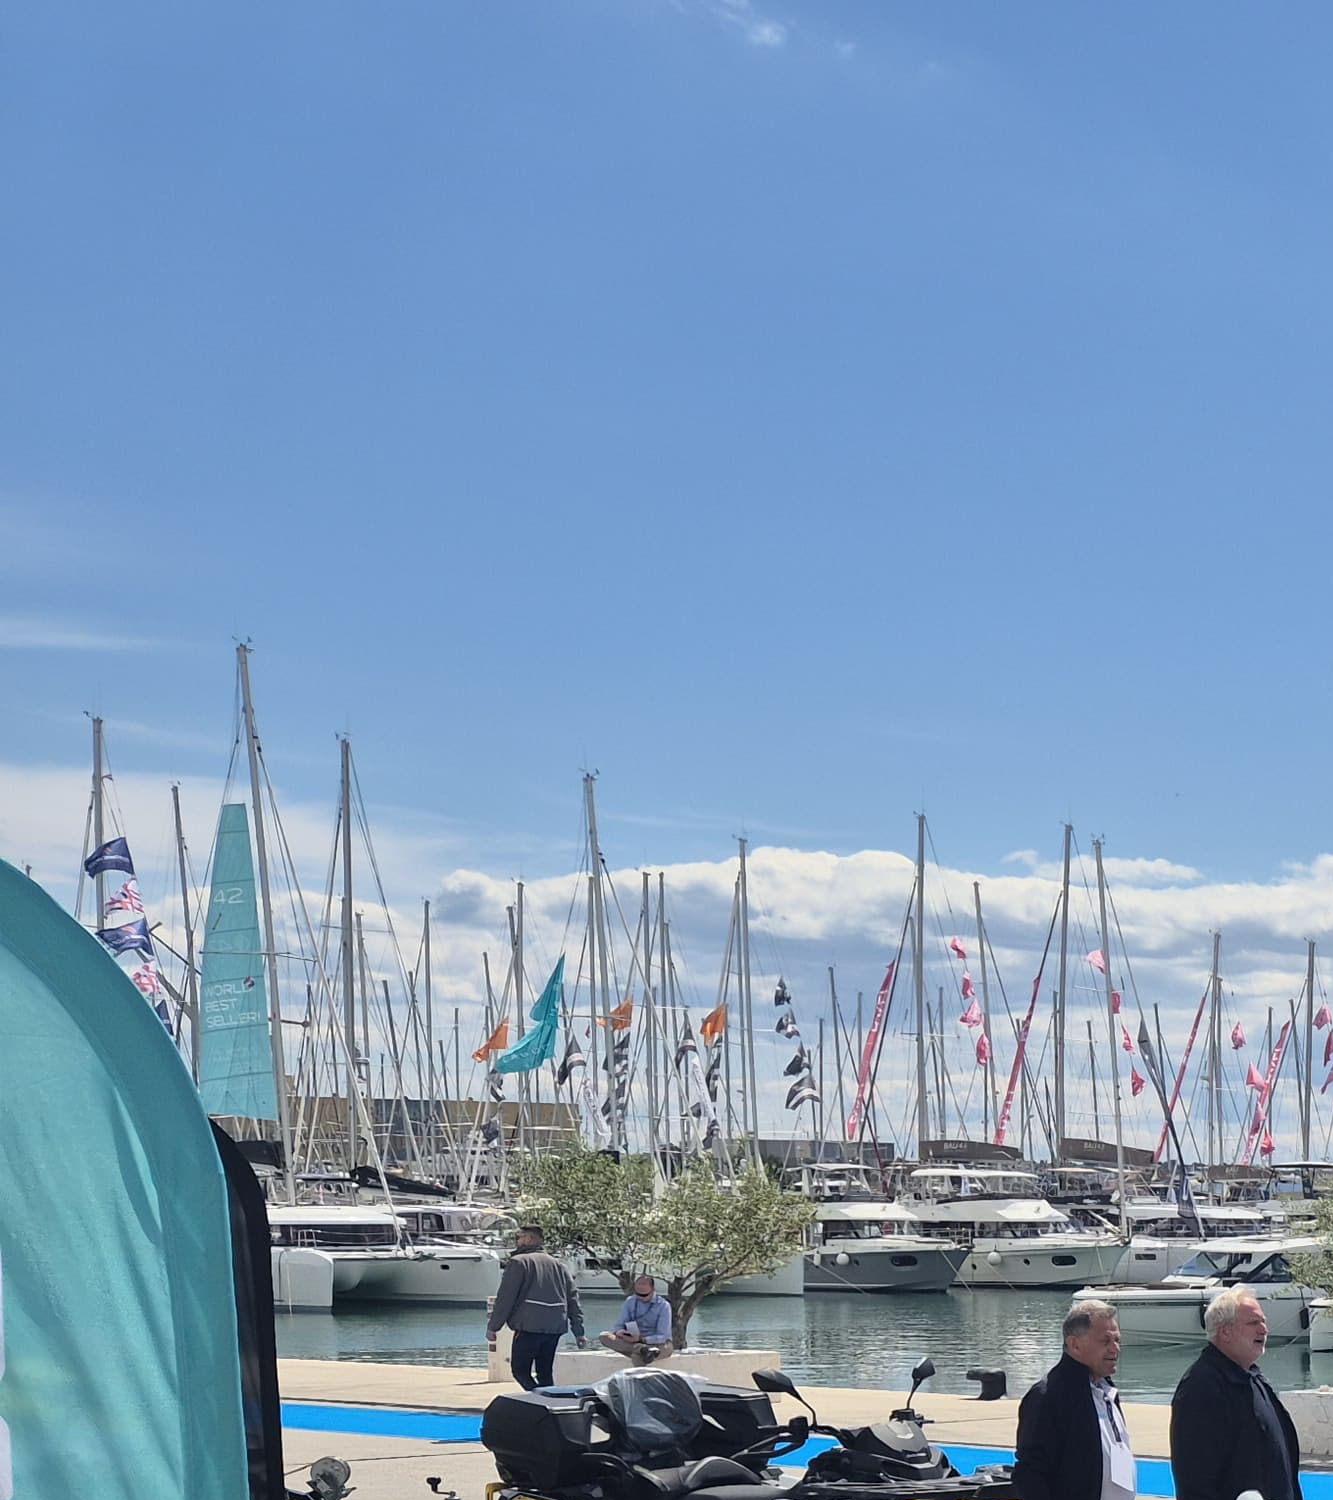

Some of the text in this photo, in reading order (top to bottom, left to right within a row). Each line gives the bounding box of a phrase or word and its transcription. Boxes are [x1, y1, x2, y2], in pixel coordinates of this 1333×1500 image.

[213, 887, 245, 904] 42
[204, 979, 255, 997] WORLD
[205, 999, 238, 1014] BEST
